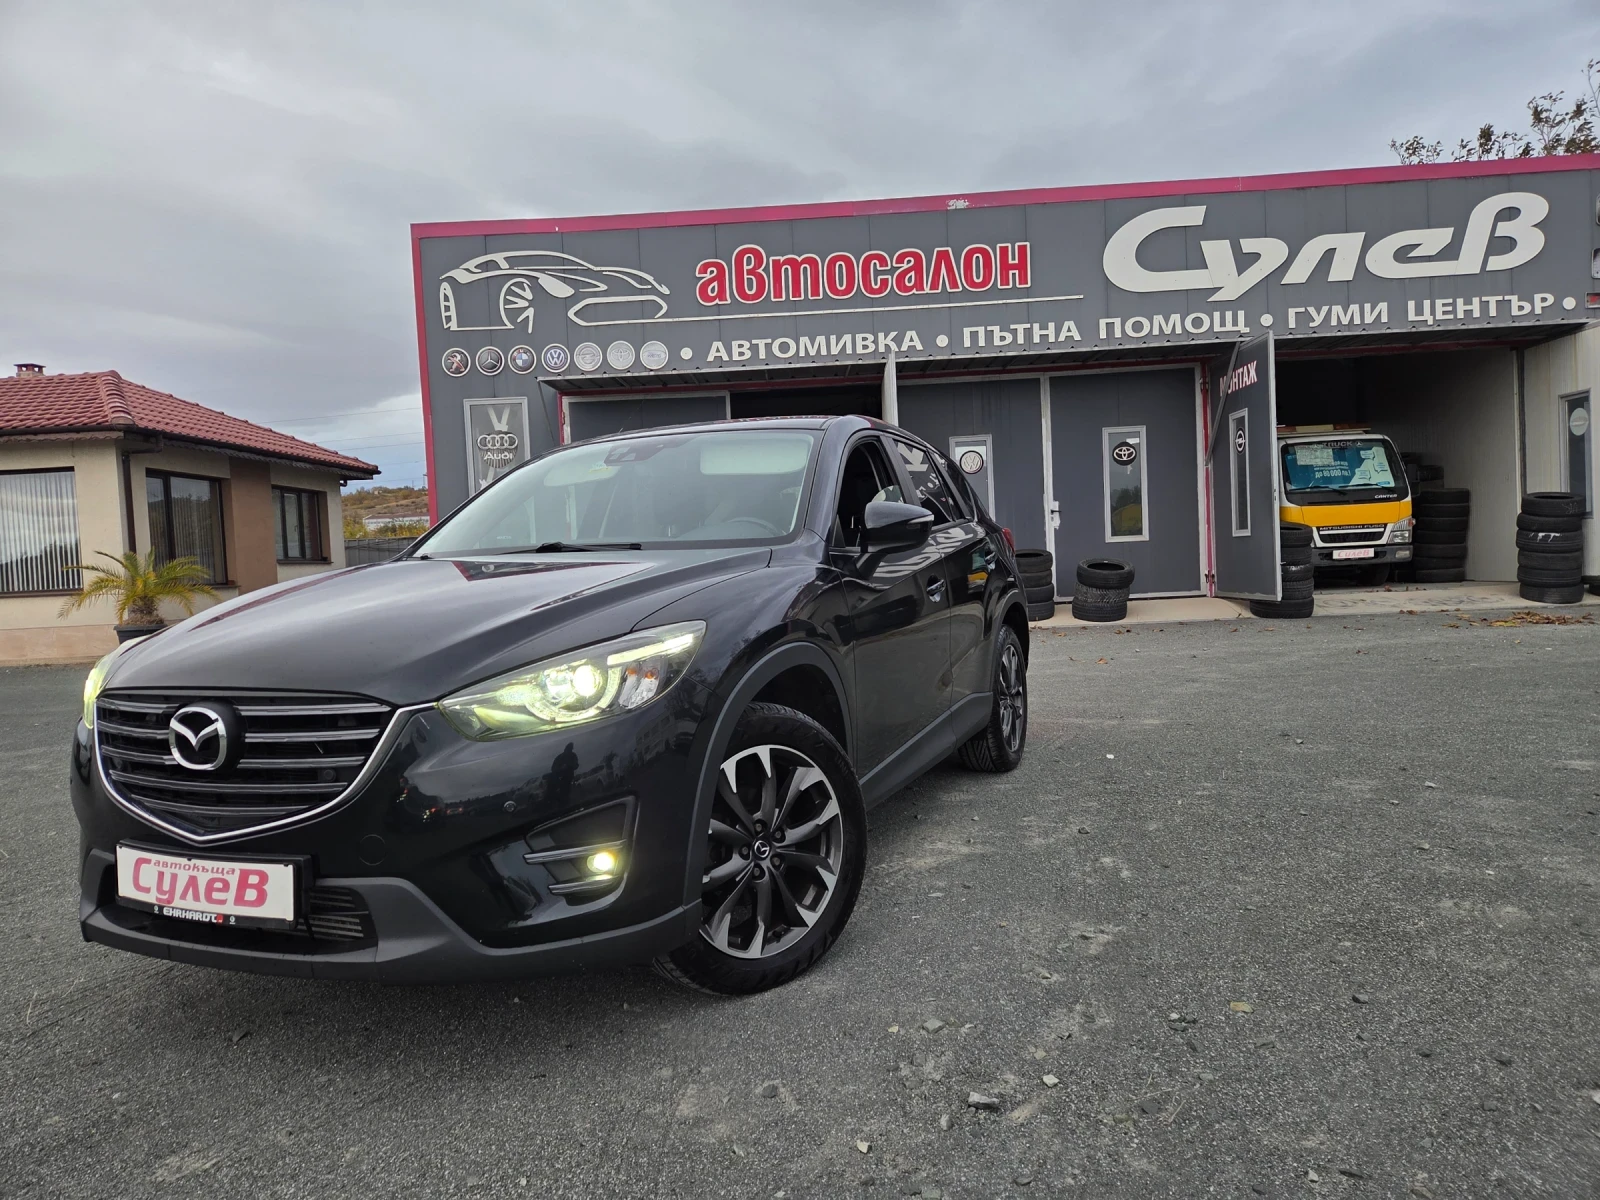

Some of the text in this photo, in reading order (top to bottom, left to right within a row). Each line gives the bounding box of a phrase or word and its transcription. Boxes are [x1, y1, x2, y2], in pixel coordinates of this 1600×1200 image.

[696, 241, 1032, 306] автосалон
[706, 293, 1555, 362] АВТОМИВКА ПЪТНА ПОМОЩ ГУМИ ЦЕНТЪР
[484, 451, 512, 460] Audi
[153, 859, 235, 875] автокъща
[163, 907, 218, 923] EHRHARDT
